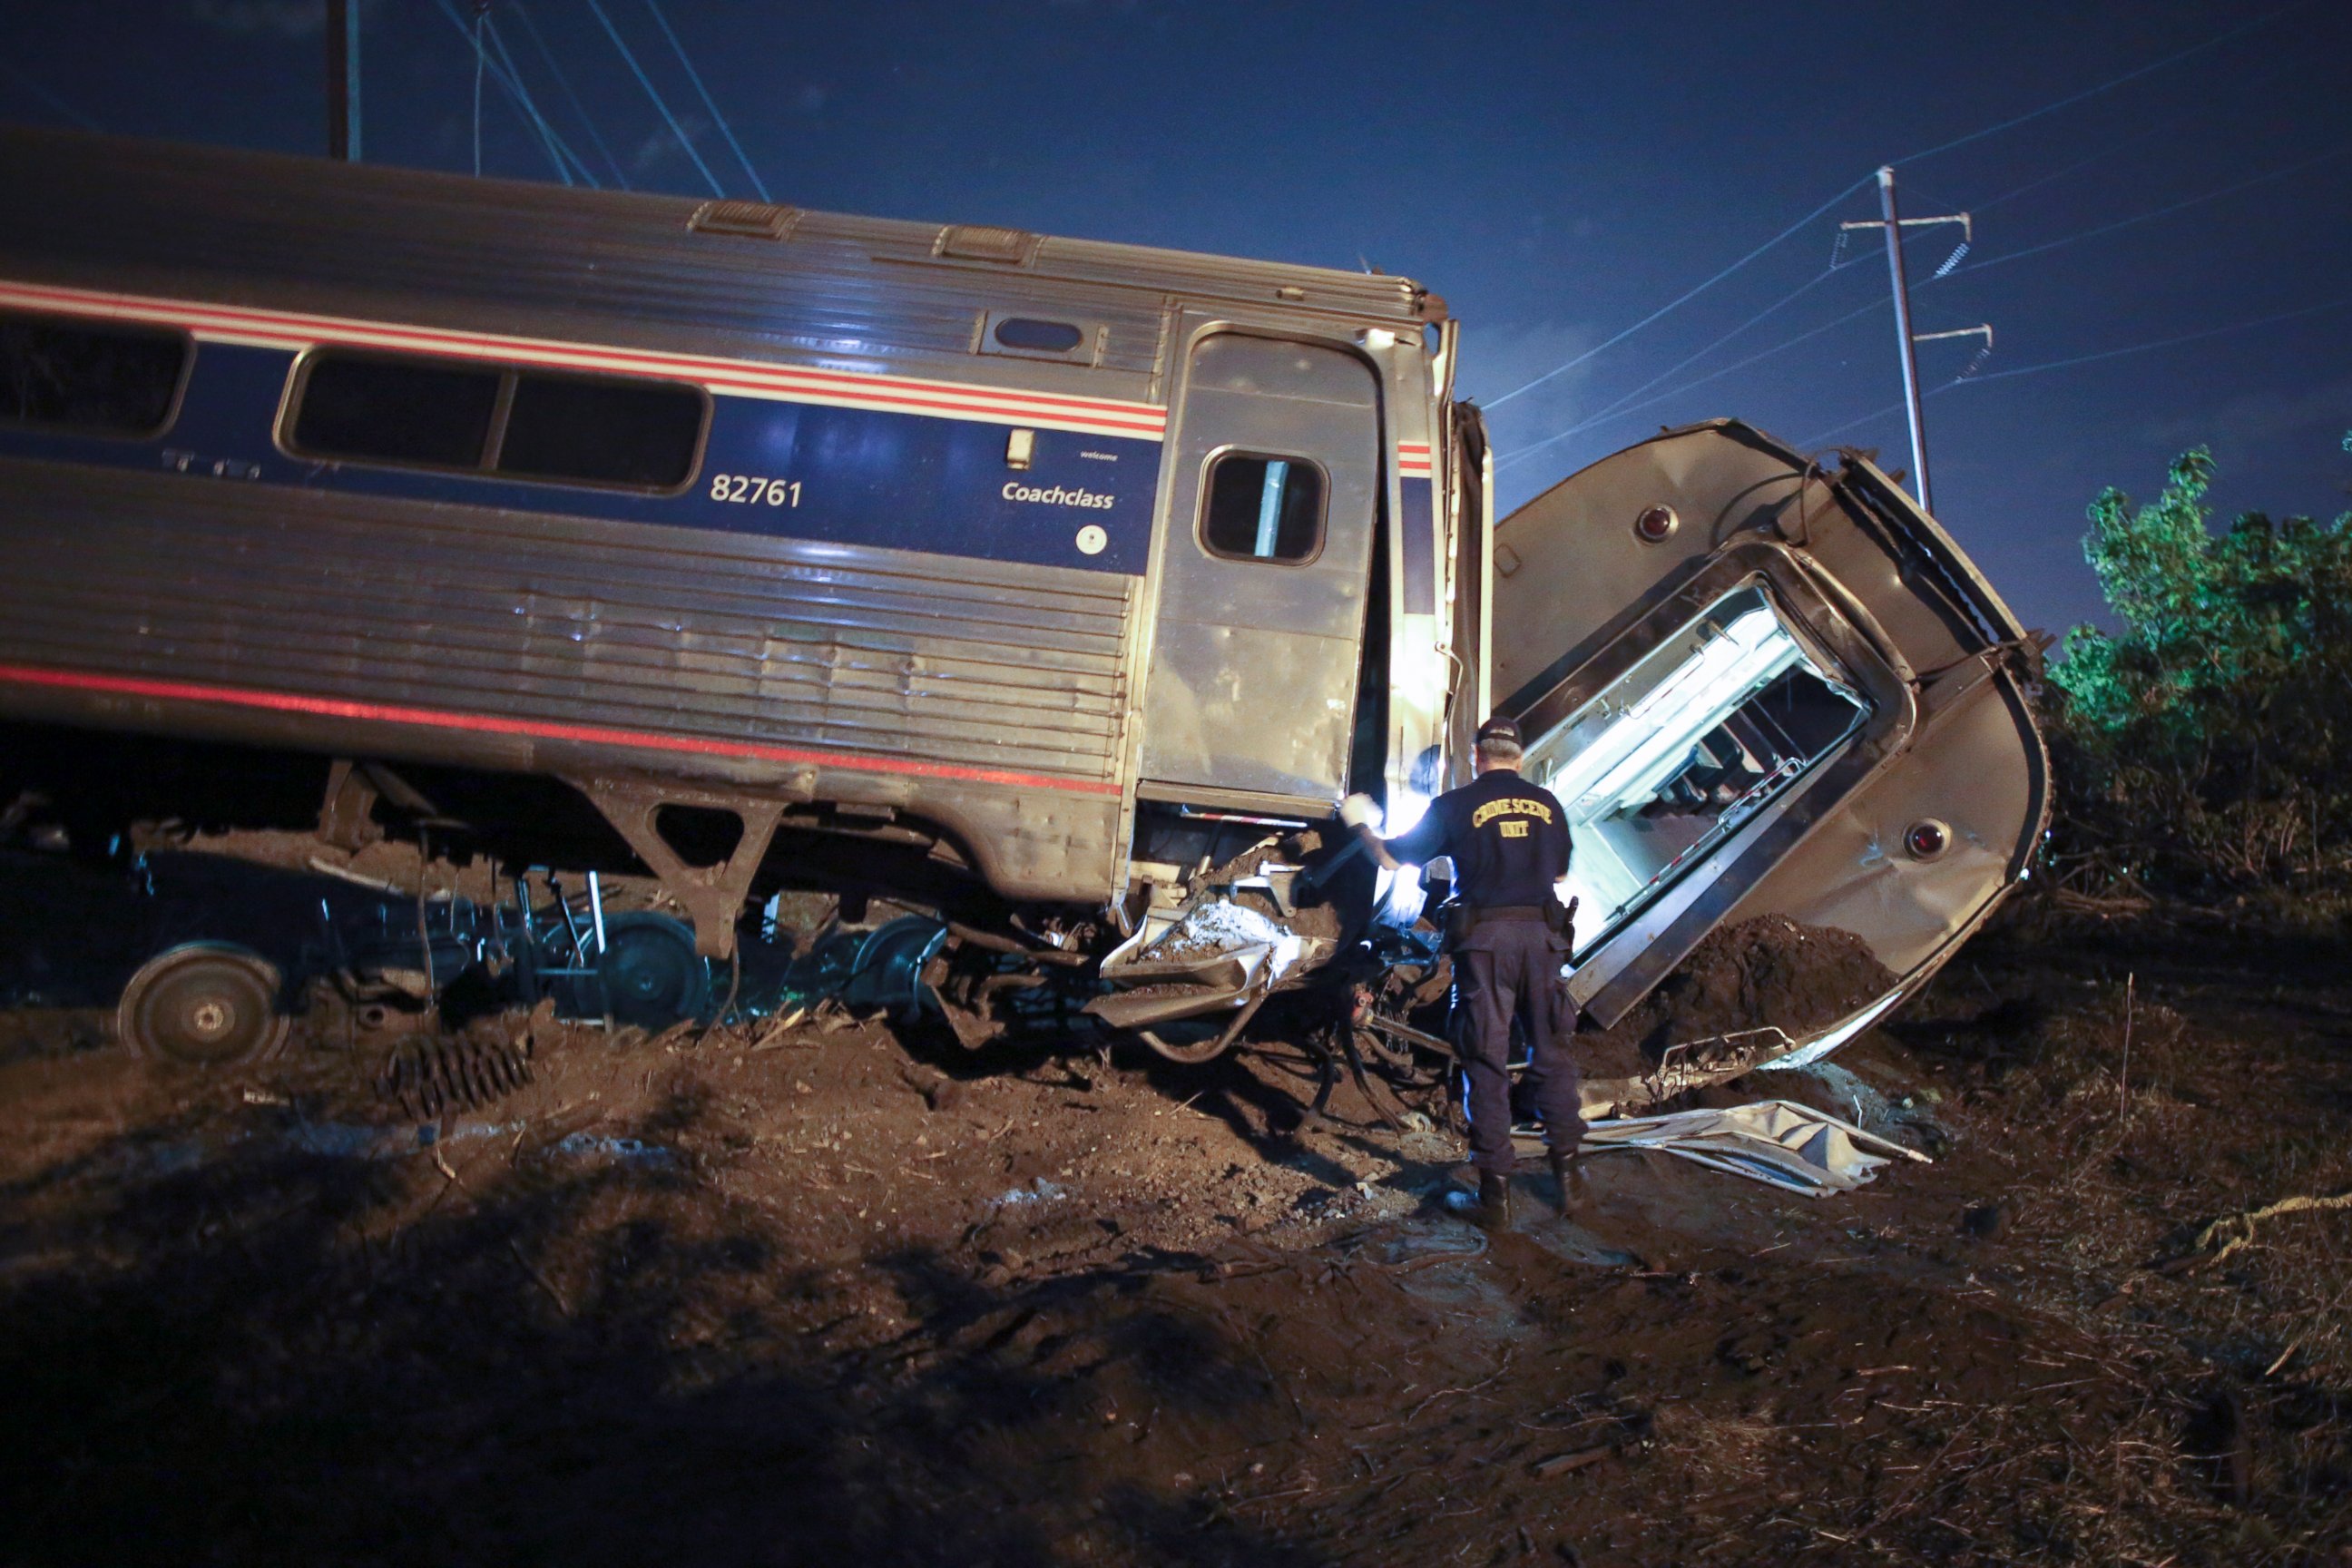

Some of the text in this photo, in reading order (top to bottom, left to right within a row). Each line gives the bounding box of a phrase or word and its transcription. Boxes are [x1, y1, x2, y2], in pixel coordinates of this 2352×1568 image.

[710, 474, 801, 508] 82761
[1002, 482, 1114, 509] Coachclass
[1473, 799, 1553, 828] CRIME SCENE
[1499, 820, 1529, 838] UNIT
